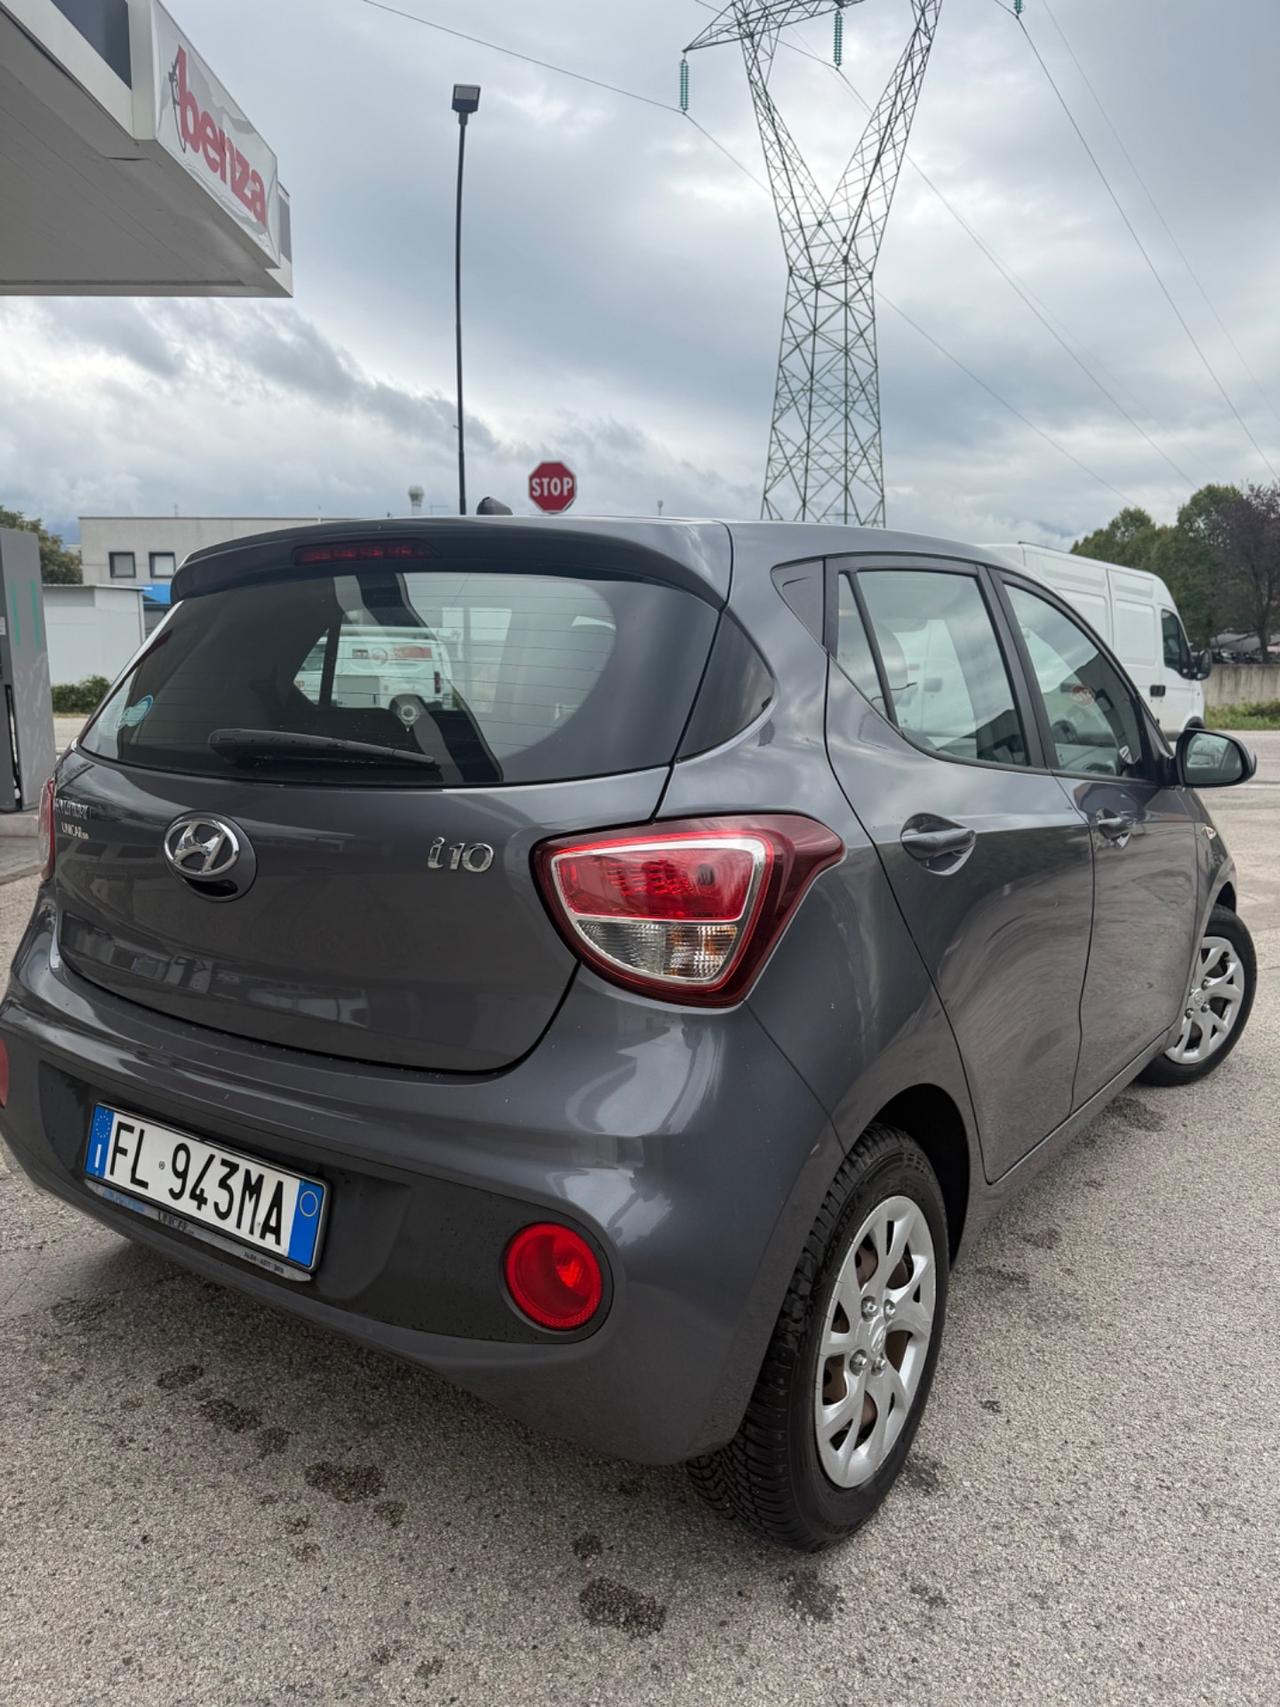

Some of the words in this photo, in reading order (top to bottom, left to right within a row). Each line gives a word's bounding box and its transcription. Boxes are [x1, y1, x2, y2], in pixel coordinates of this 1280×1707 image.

[177, 46, 267, 230] benza
[531, 477, 573, 497] STOP
[427, 836, 494, 873] i10
[109, 1121, 149, 1190] FL
